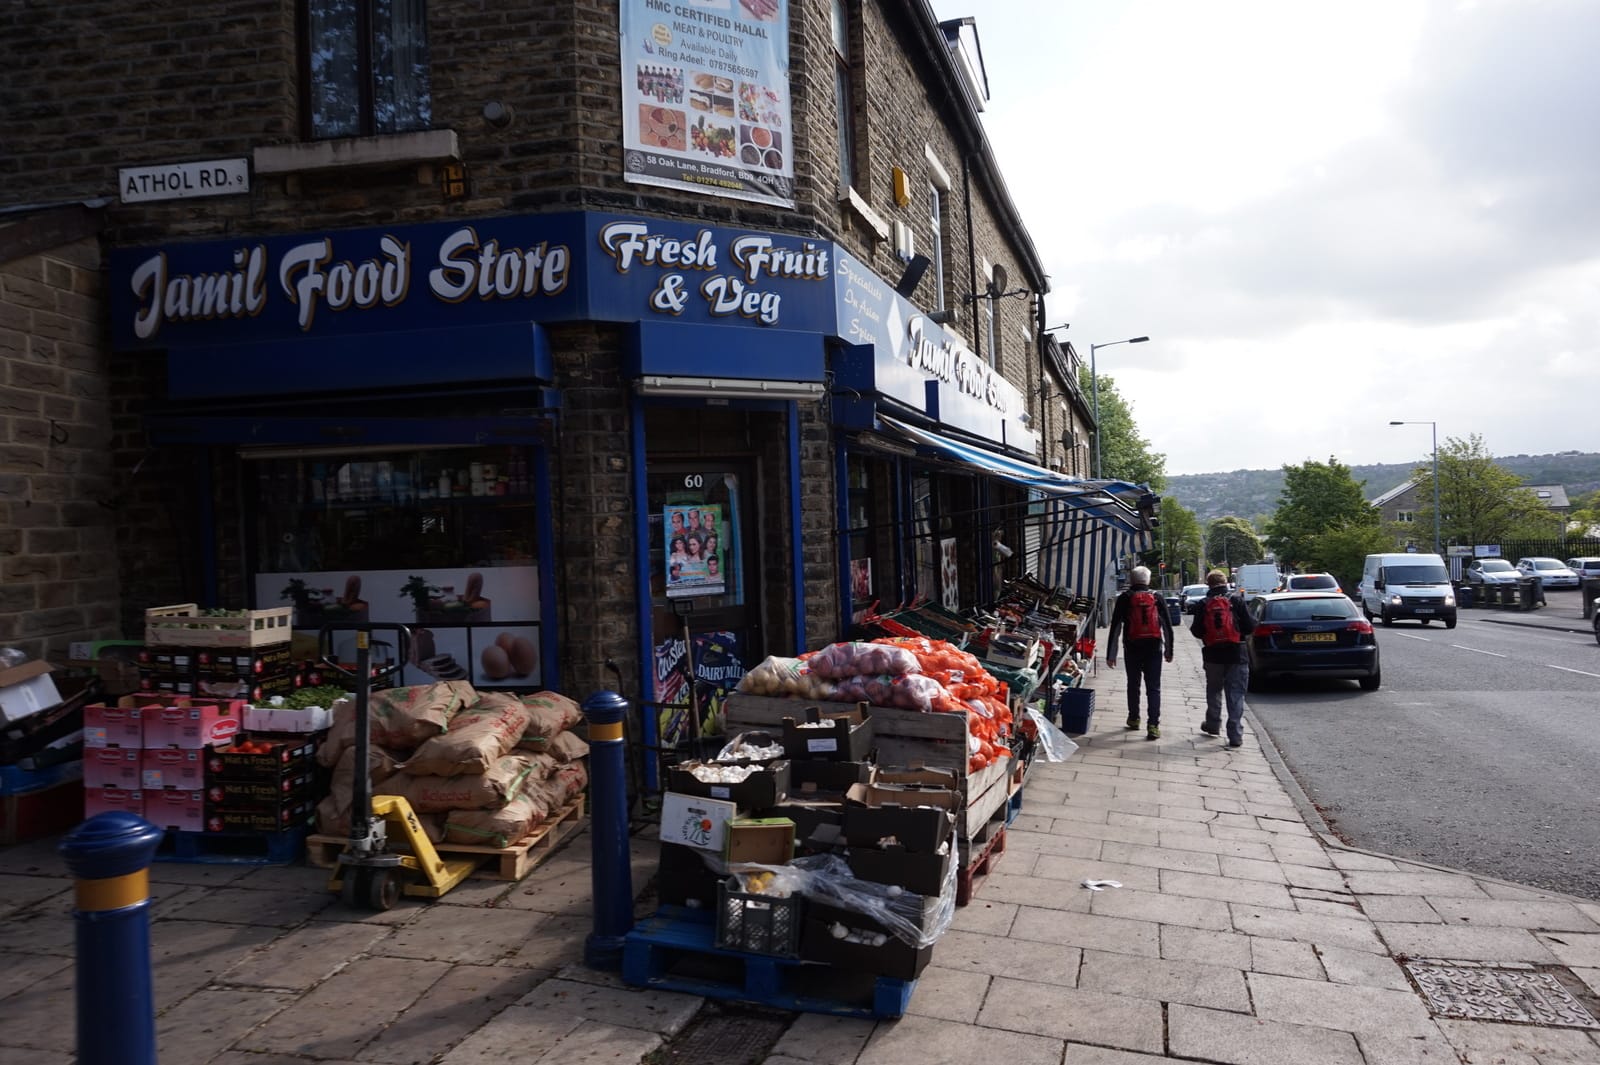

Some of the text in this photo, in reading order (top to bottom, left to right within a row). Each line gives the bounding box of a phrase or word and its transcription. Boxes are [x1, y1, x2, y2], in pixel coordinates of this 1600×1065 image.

[646, 0, 768, 39] HMC CERTIFIED HALAL
[672, 21, 744, 48] MEAT & POULTRY
[658, 46, 678, 61] Ring
[679, 51, 706, 67] Adeel:
[680, 39, 738, 62] Available Daily
[646, 155, 657, 165] 58
[658, 157, 675, 168] Oak
[677, 159, 698, 173] Lane,
[700, 164, 736, 179] Bradford,
[126, 171, 193, 194] ATHOL
[200, 168, 232, 188] RD.
[696, 176, 718, 186] 01274
[600, 222, 829, 283] Fresh Fruit
[130, 226, 570, 340] Jamil Food Store
[650, 273, 781, 326] & Veg
[908, 314, 952, 383] Jamil
[684, 474, 703, 488] 60
[698, 663, 725, 681] DAIRY
